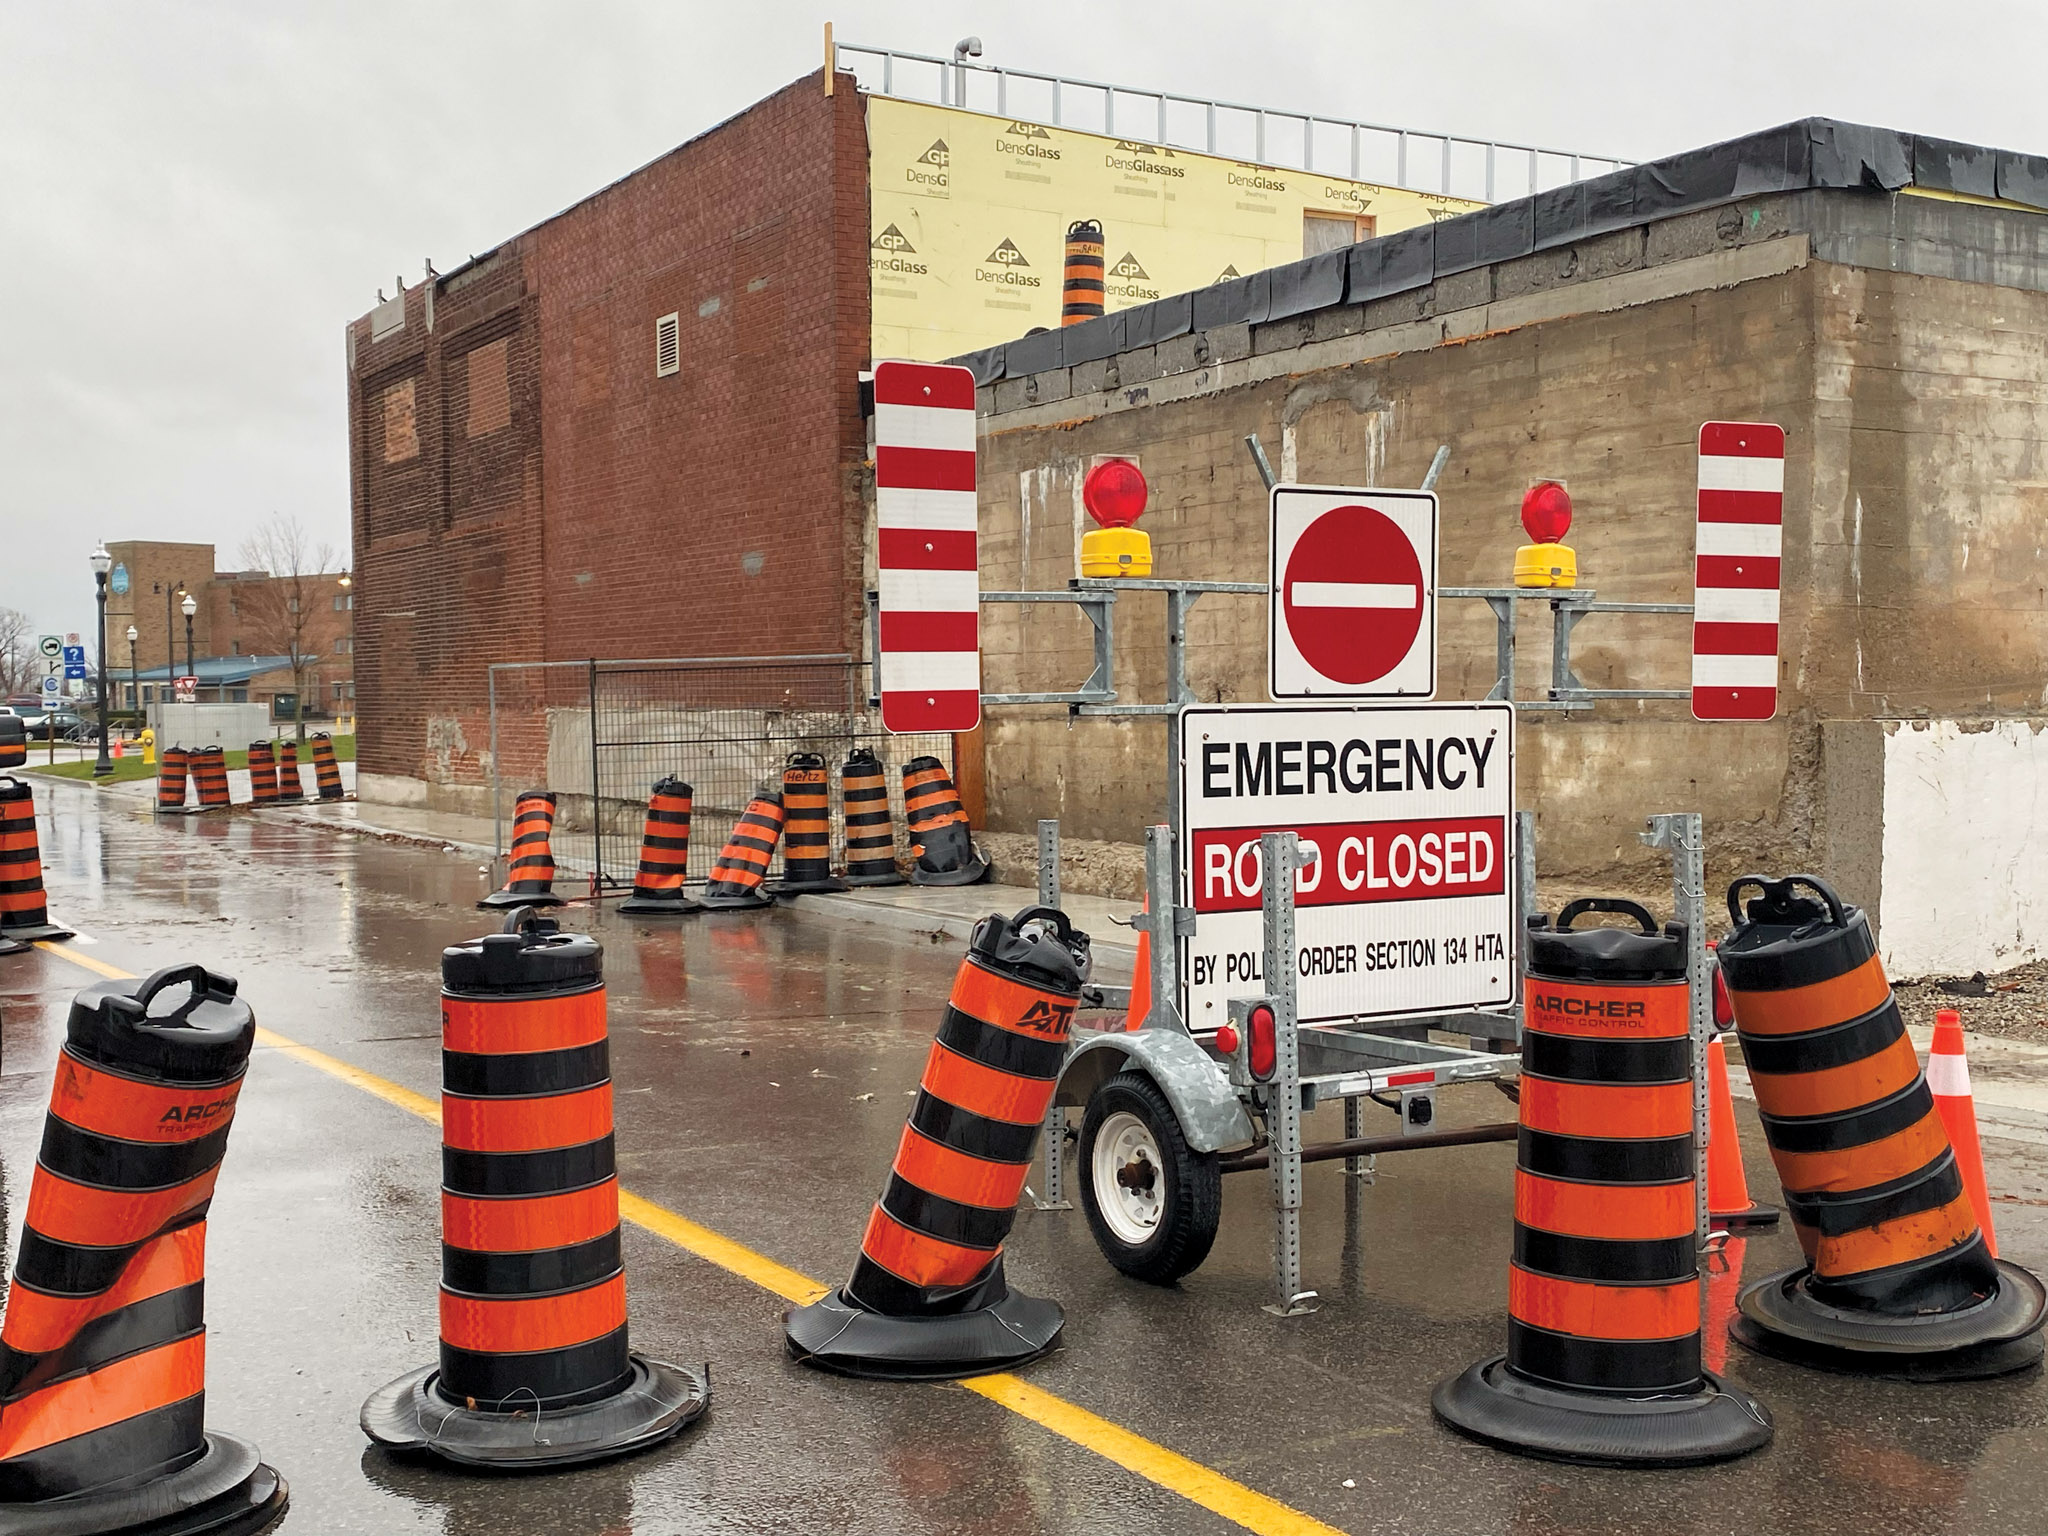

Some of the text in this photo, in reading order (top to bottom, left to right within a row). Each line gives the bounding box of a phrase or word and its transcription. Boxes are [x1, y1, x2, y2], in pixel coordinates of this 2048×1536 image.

[996, 139, 1061, 160] DensGlass
[1227, 172, 1286, 192] DensGlass
[1325, 186, 1358, 202] DensG
[880, 234, 905, 250] GP
[995, 249, 1019, 263] GP
[871, 258, 928, 275] ensGlass
[1117, 262, 1140, 277] GP
[975, 268, 1041, 288] DensGlass
[787, 771, 820, 782] Hertz
[1202, 737, 1496, 798] EMERGENCY
[1205, 831, 1495, 898] ROD CLOSED
[1194, 955, 1217, 985] BY
[1299, 944, 1358, 977] ORDER
[1365, 938, 1436, 972] SECTION
[1443, 938, 1468, 965] 134
[1474, 933, 1505, 962] HTA
[1535, 994, 1645, 1017] ARCHER
[1578, 1018, 1645, 1028] CONTROL
